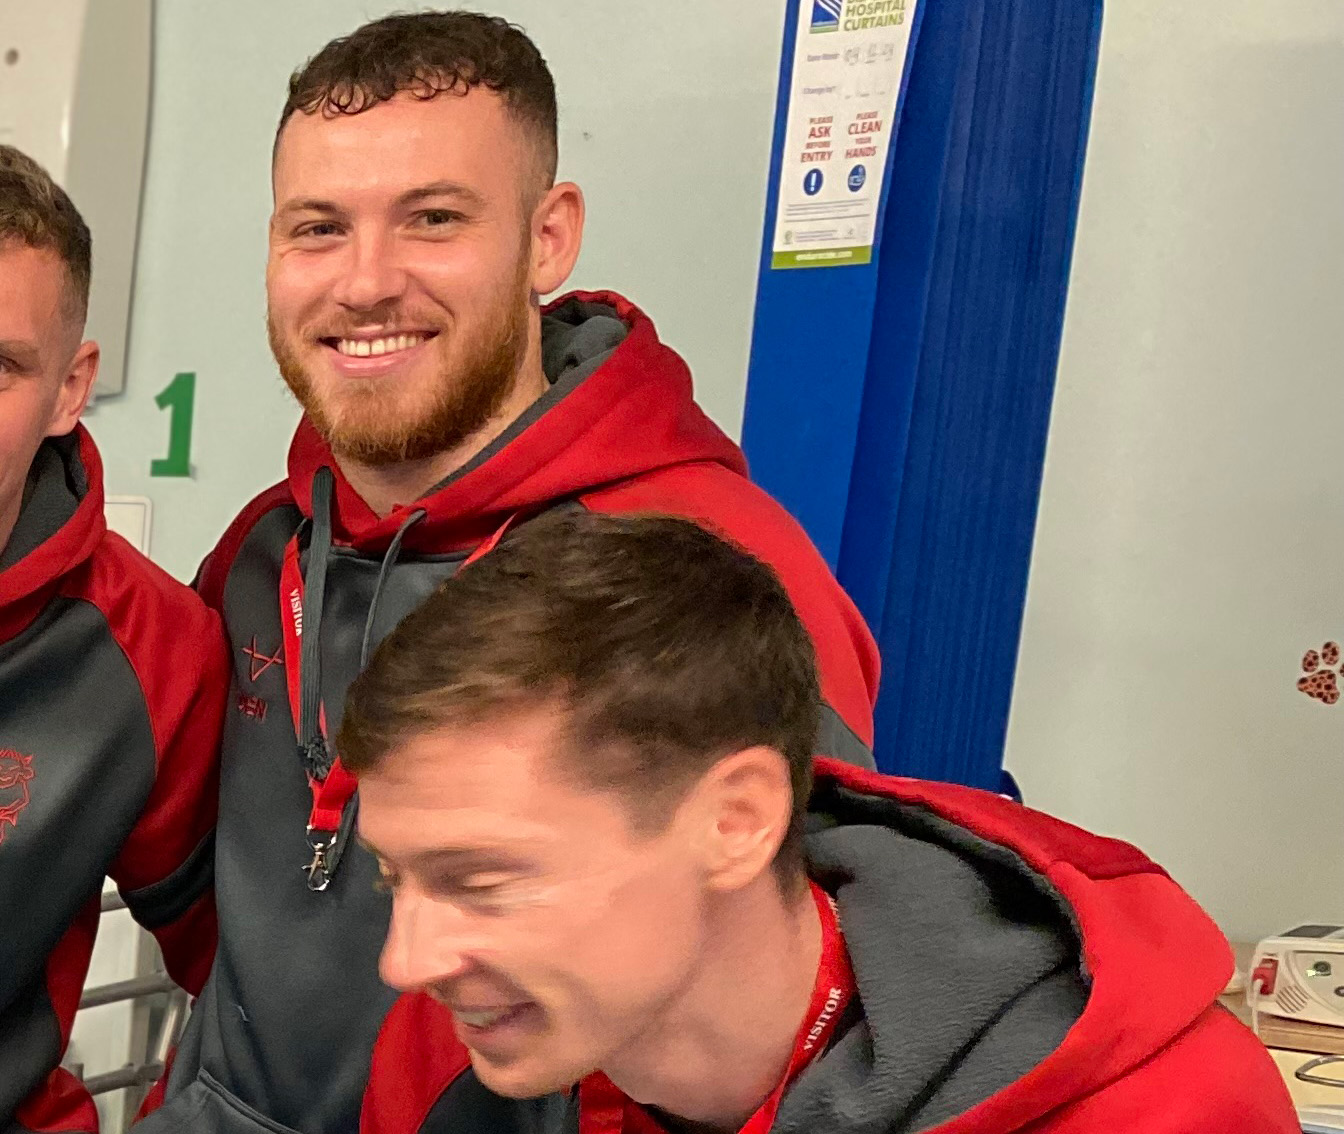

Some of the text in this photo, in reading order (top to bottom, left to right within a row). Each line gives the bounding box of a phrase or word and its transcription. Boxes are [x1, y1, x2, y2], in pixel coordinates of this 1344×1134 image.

[845, 0, 906, 17] HOSPITAL
[843, 12, 905, 32] CURTAINS
[808, 126, 832, 139] ASK
[848, 120, 883, 135] CLEAN
[800, 151, 833, 163] ENTRY
[845, 146, 877, 159] HANDS
[150, 372, 196, 477] 1
[803, 987, 842, 1051] VISITOR
